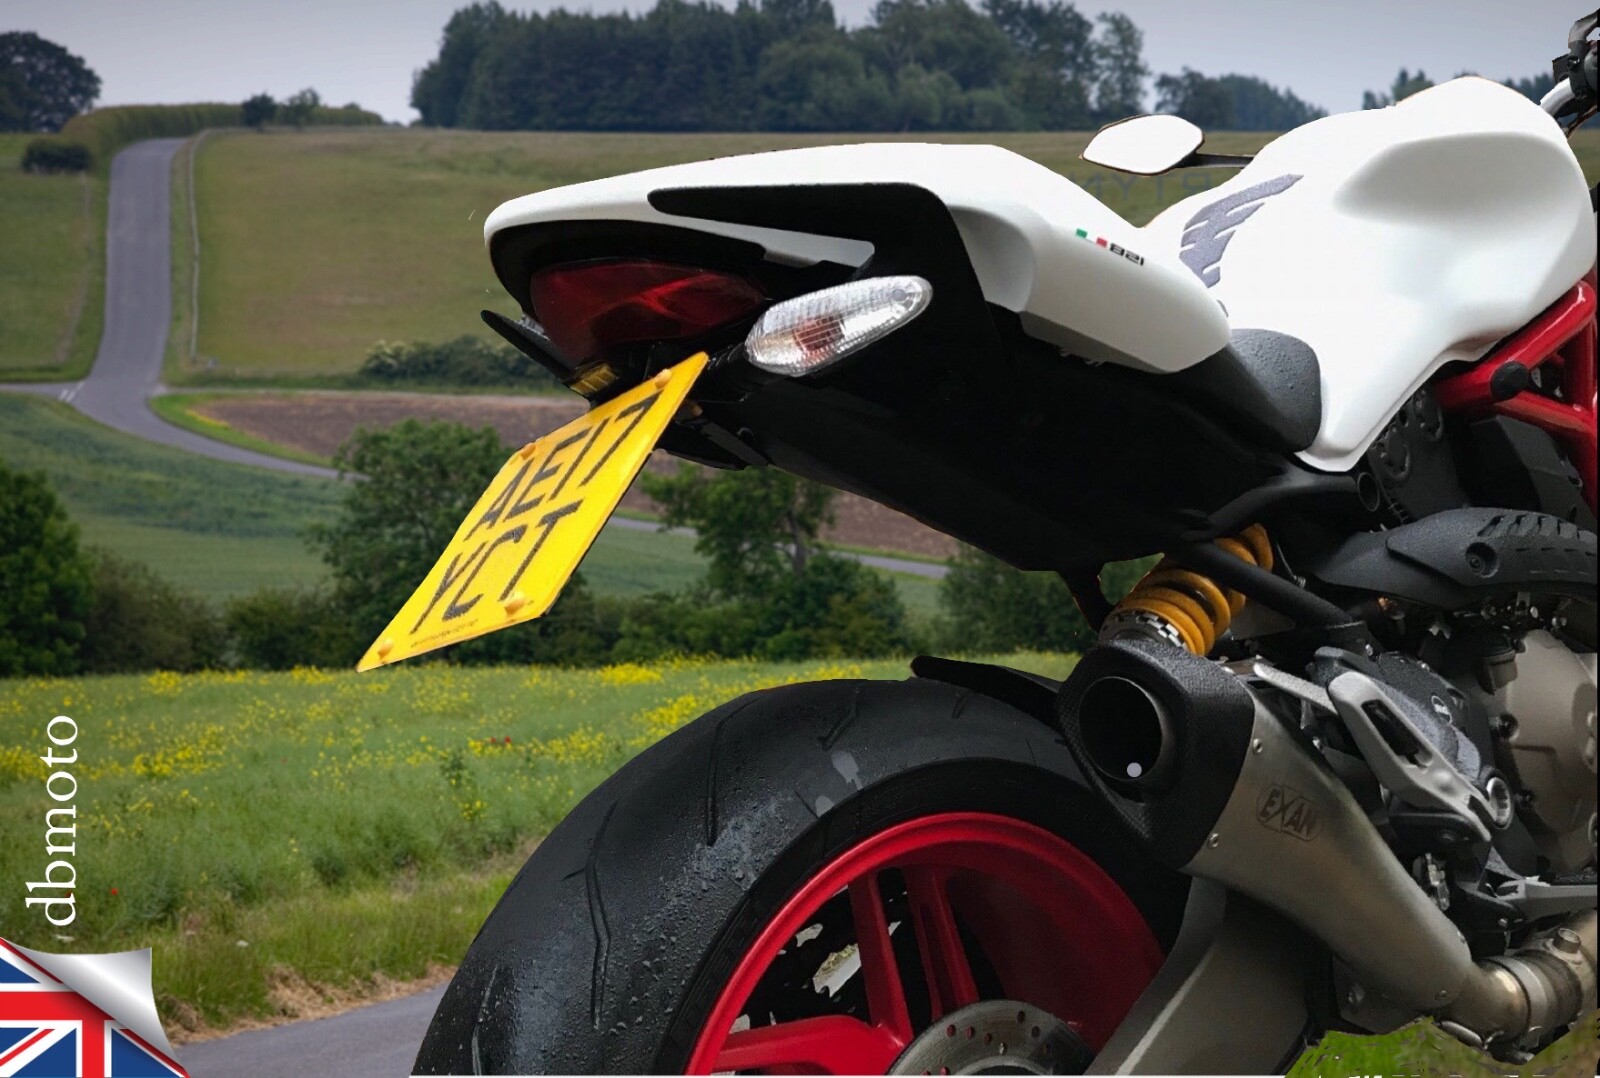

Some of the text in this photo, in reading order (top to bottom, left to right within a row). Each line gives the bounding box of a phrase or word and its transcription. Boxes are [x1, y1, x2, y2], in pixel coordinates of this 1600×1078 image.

[1109, 242, 1144, 266] 821
[463, 389, 664, 542] AE17
[408, 499, 585, 636] YCT
